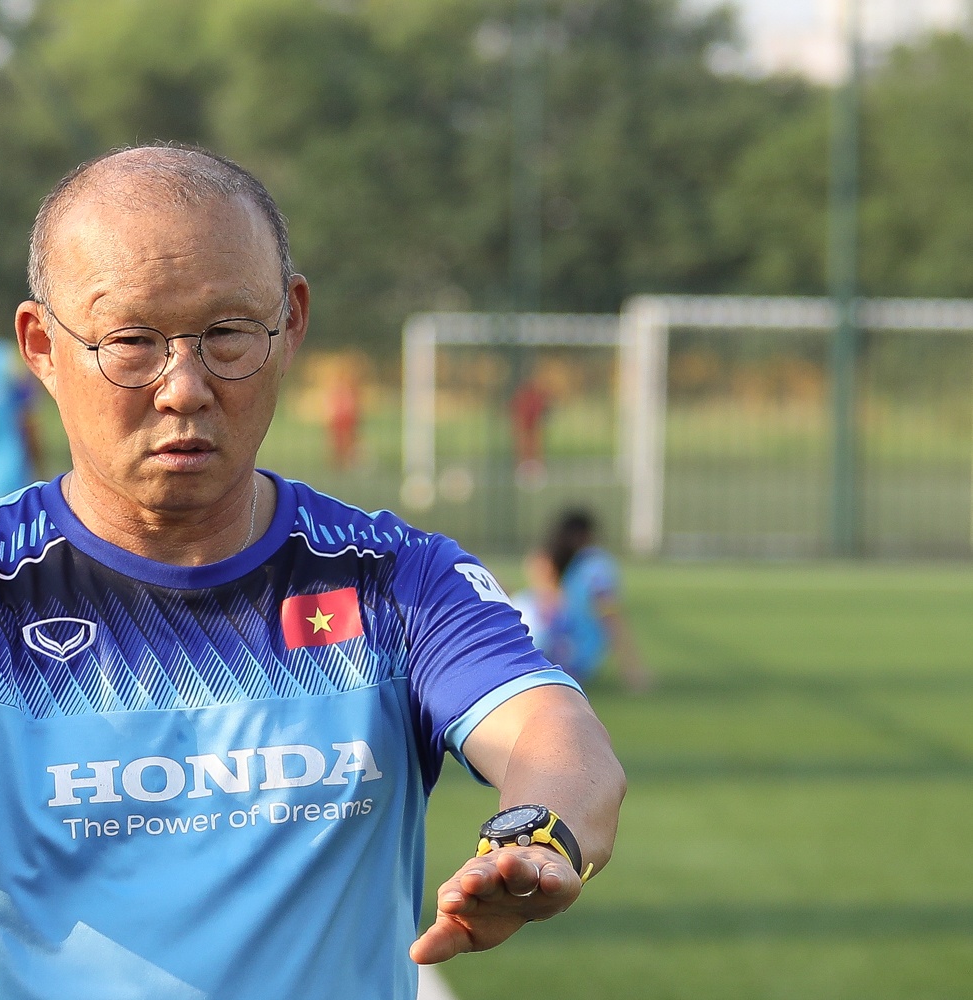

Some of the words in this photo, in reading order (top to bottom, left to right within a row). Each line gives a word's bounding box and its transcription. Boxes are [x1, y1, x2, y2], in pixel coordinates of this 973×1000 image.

[46, 740, 383, 807] HONDA
[63, 817, 119, 840] The
[128, 812, 221, 836] Power
[229, 804, 259, 828] of
[269, 797, 373, 824] Dreams
